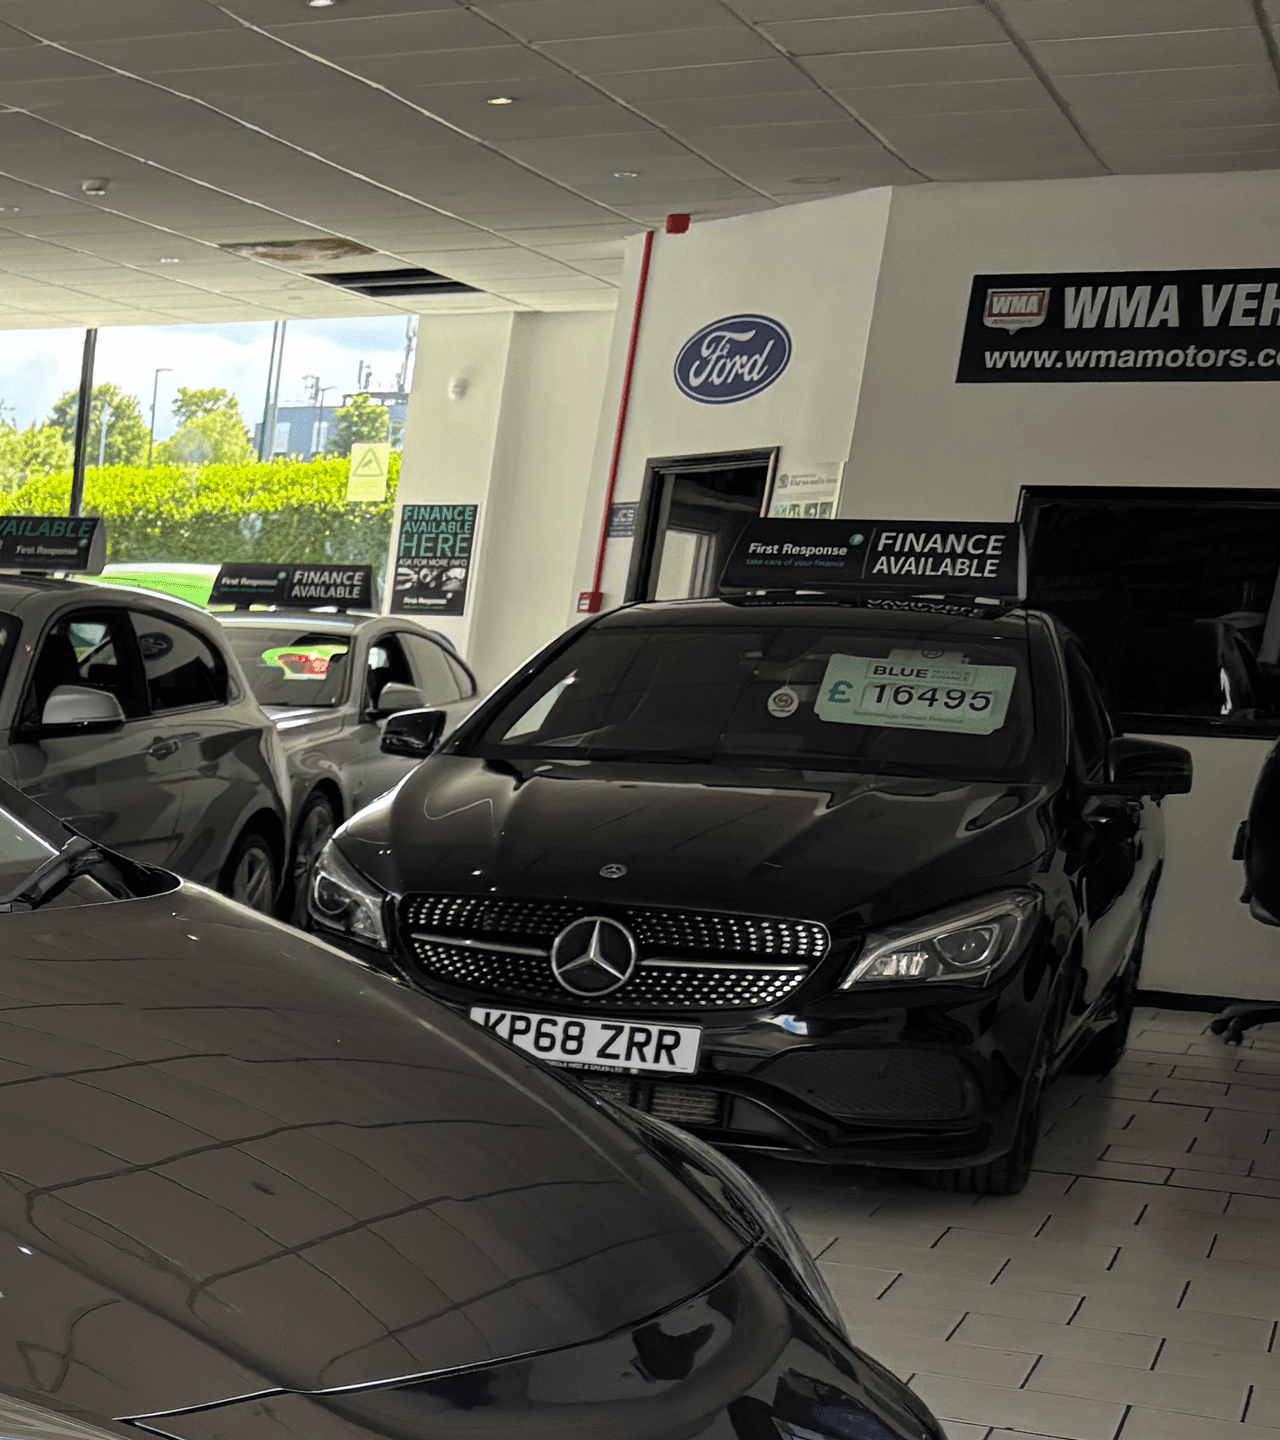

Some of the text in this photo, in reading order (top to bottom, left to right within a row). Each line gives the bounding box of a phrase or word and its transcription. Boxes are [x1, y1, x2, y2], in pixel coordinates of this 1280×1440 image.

[992, 294, 1039, 314] WMA
[1064, 285, 1180, 329] WMA
[689, 330, 775, 387] Ford
[984, 345, 1280, 370] www.wmamotors.c
[403, 506, 474, 521] FINANCE
[402, 521, 472, 534] AVAILABLE
[399, 534, 471, 557] HERE
[749, 543, 848, 557] First Response
[877, 532, 1006, 556] FINANCE
[292, 571, 364, 585] FINANCE
[872, 556, 1000, 578] AVAILABLE
[291, 585, 361, 599] AVAILABLE
[873, 665, 929, 679] BLUE
[827, 680, 993, 712] £ 16495
[484, 1011, 681, 1066] KP68 ZRR
